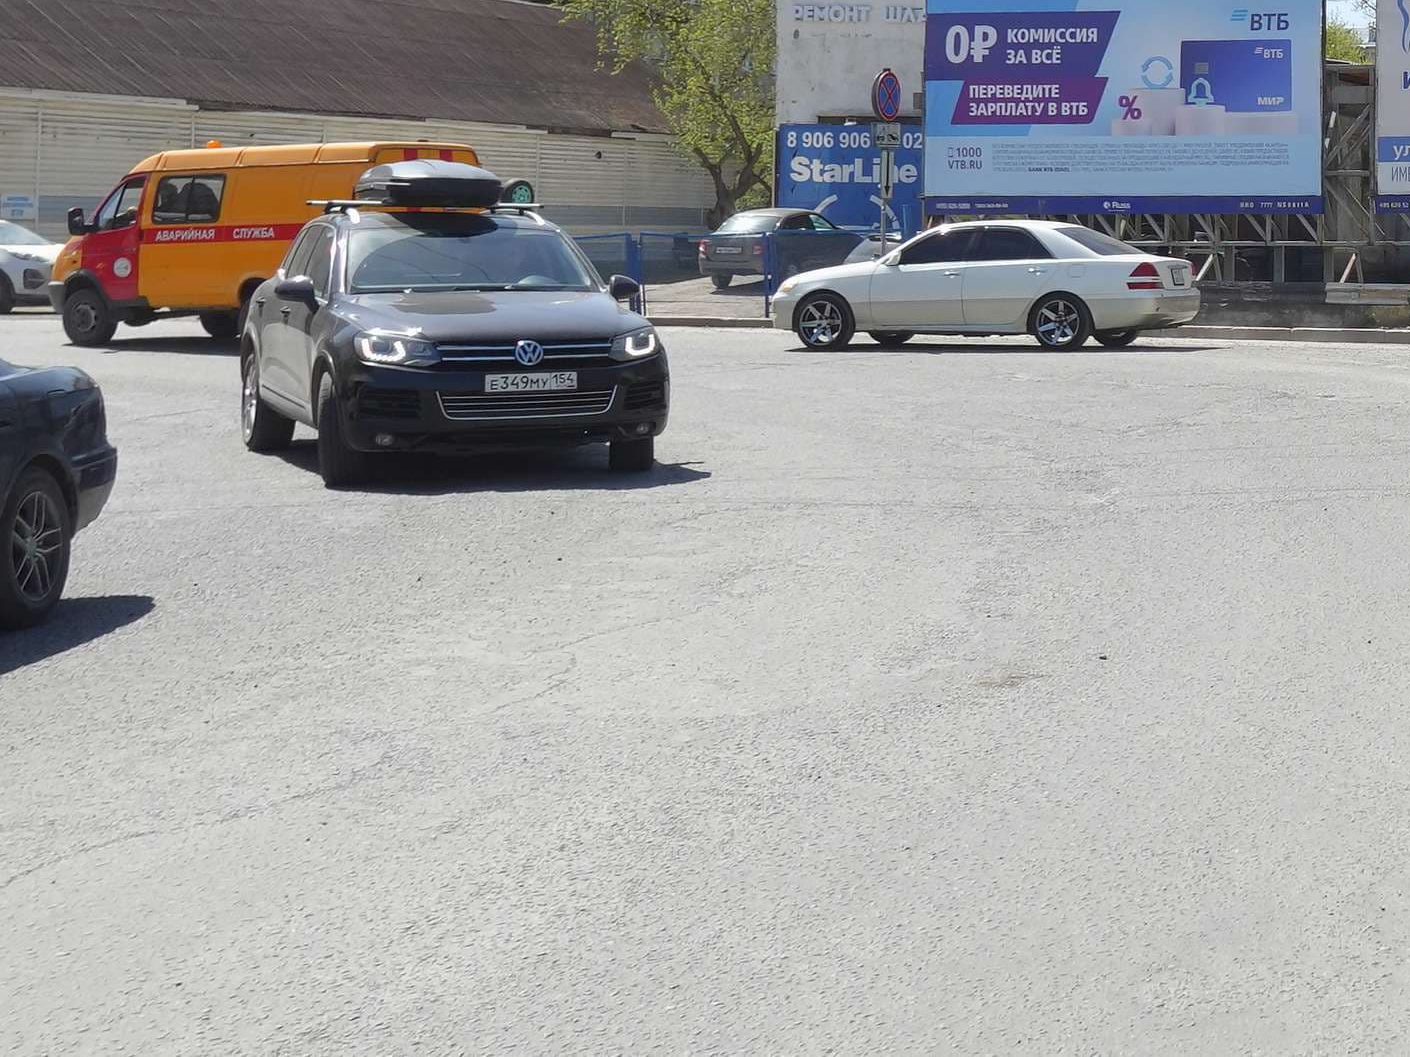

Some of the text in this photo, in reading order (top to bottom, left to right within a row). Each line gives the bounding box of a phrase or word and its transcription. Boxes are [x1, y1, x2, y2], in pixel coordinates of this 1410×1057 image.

[793, 5, 872, 23] РЕМОНТ
[1250, 13, 1290, 31] ВТБ
[1007, 27, 1098, 43] КОМИССИЯ
[1006, 45, 1061, 64] ЗА ВСЁ
[1263, 48, 1283, 59] ВТБ
[968, 84, 1060, 100] ПЕРЕВЕДИТЕ
[968, 102, 1089, 116] ЗАРПЛАТУ В ВТБ
[787, 131, 797, 148] 8
[802, 132, 834, 148] 906
[839, 132, 871, 148] 906
[955, 147, 982, 158] 1000
[155, 227, 275, 241] АВАРИЙНАЯ СЛУЖБА
